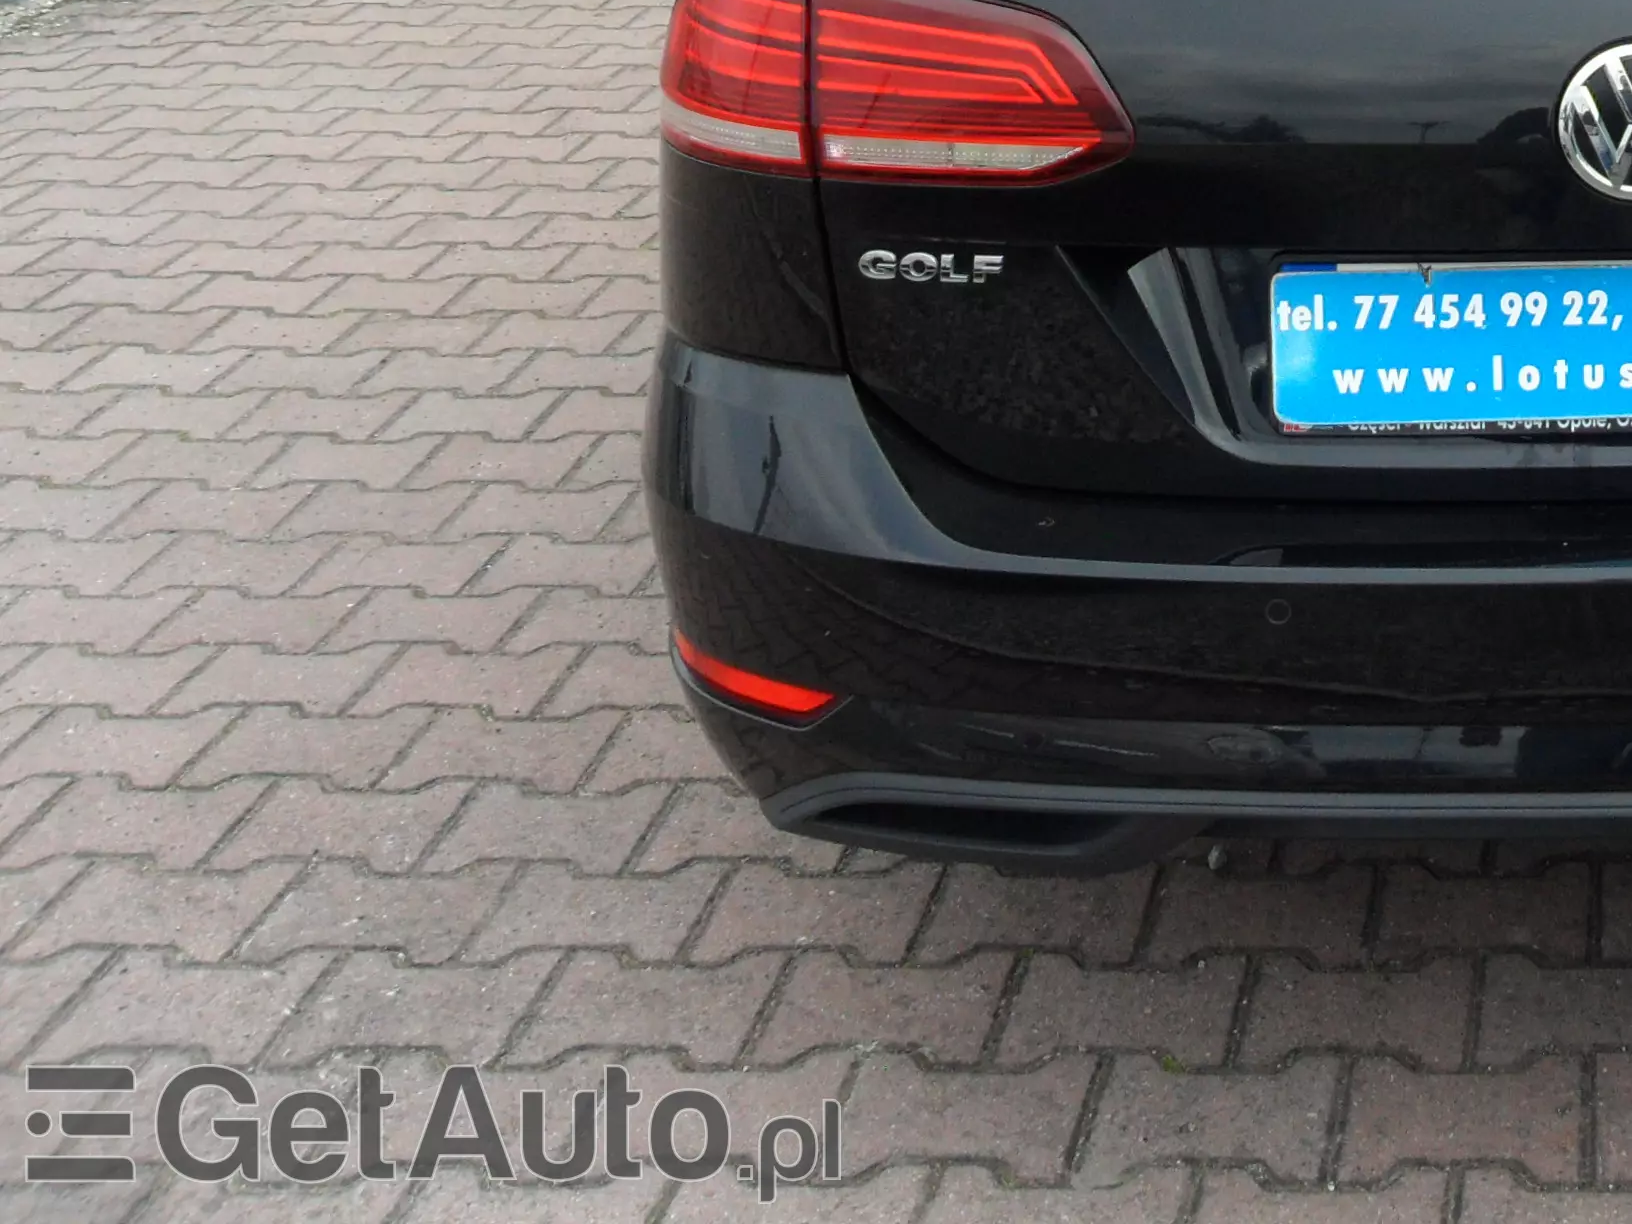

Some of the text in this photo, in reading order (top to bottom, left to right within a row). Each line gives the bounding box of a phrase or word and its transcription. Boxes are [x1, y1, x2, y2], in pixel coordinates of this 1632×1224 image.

[858, 249, 1004, 283] GOLF
[1277, 294, 1338, 331] tel.
[1354, 294, 1400, 330] 77
[1413, 293, 1486, 329] 454
[1500, 291, 1548, 327] 99
[1562, 290, 1624, 331] 22,
